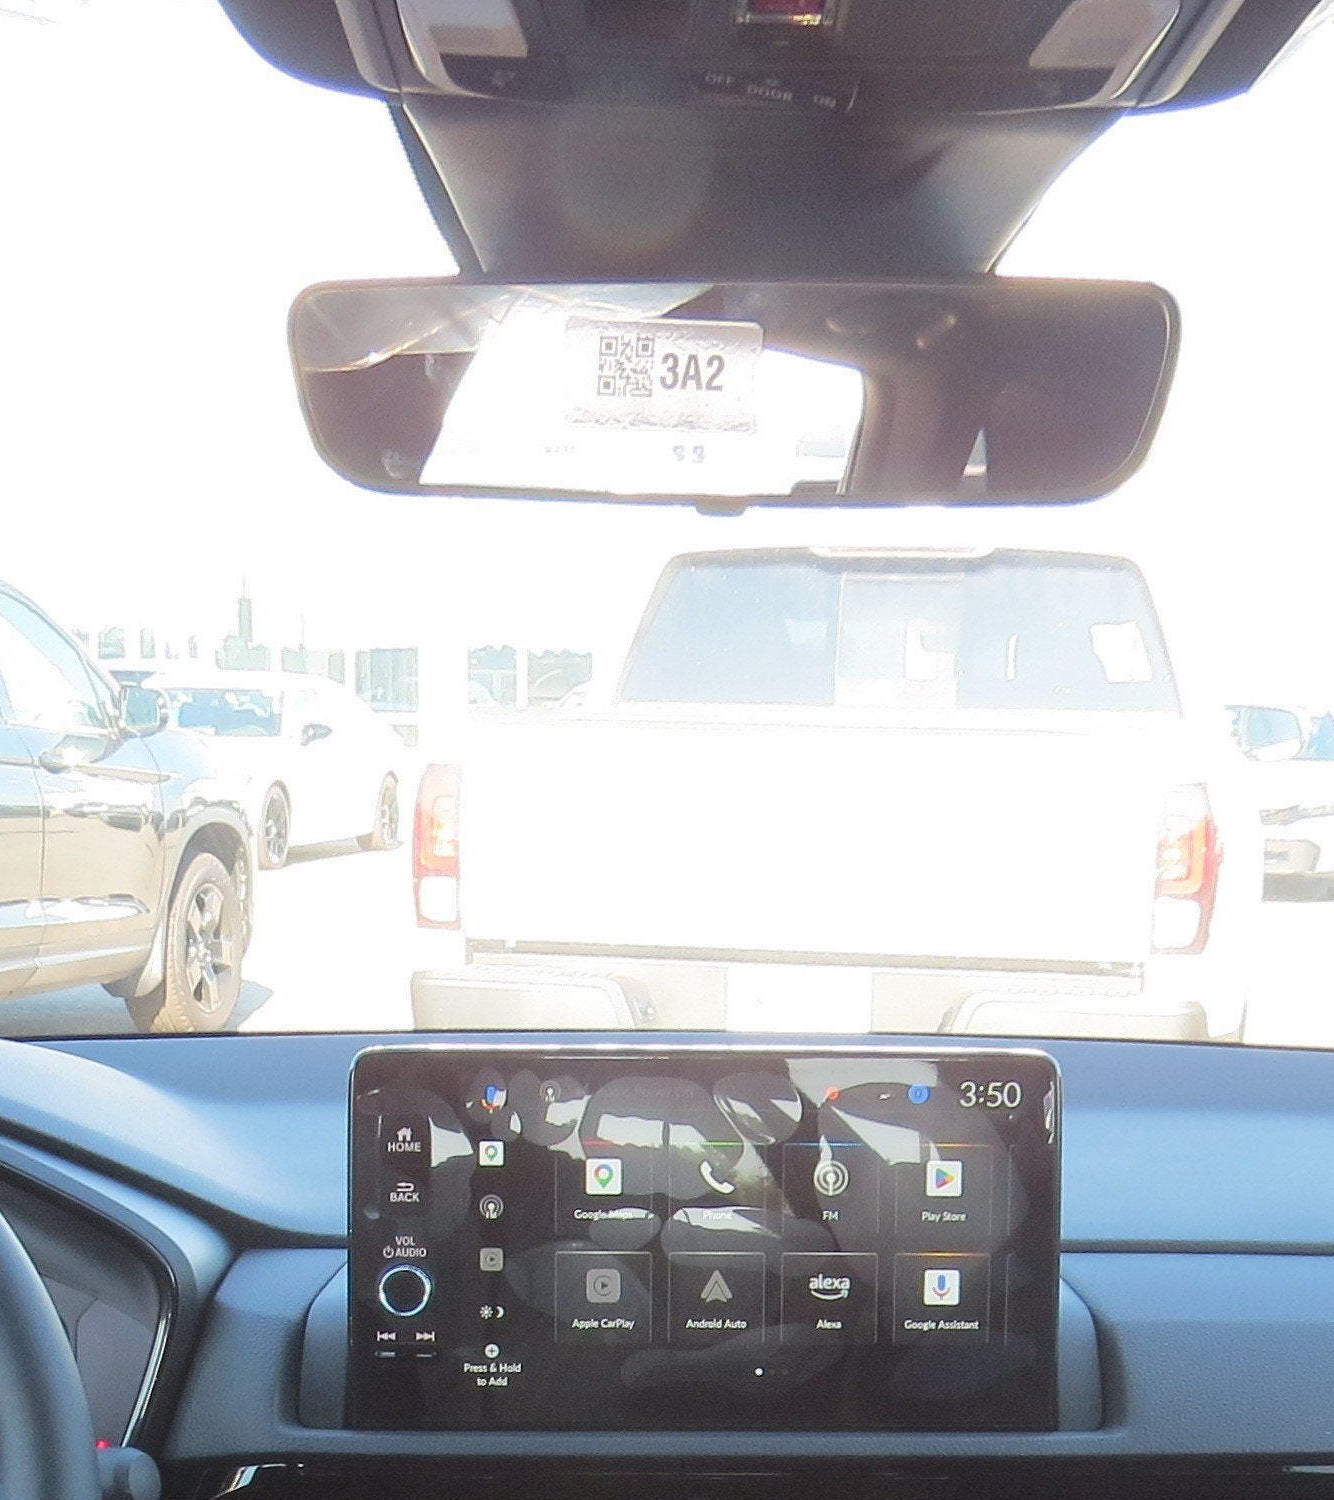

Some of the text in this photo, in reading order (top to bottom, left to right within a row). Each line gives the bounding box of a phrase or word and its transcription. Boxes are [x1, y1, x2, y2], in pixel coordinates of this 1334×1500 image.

[659, 352, 726, 391] 3A2
[959, 1081, 1022, 1109] 3:50
[387, 1142, 421, 1152] HOME
[389, 1193, 420, 1203] BACK
[574, 1209, 608, 1221] Google
[822, 1211, 839, 1221] FM
[921, 1211, 966, 1223] Play Store
[395, 1236, 416, 1246] VOL
[395, 1248, 427, 1258] AUDIO
[809, 1273, 851, 1290] alexa
[572, 1318, 635, 1330] Apple CarPlay
[686, 1318, 747, 1329] Android Auto
[816, 1319, 842, 1330] Alexa
[904, 1319, 979, 1331] Google Assistant
[463, 1362, 522, 1373] Press & Hold
[477, 1376, 508, 1387] to Add
